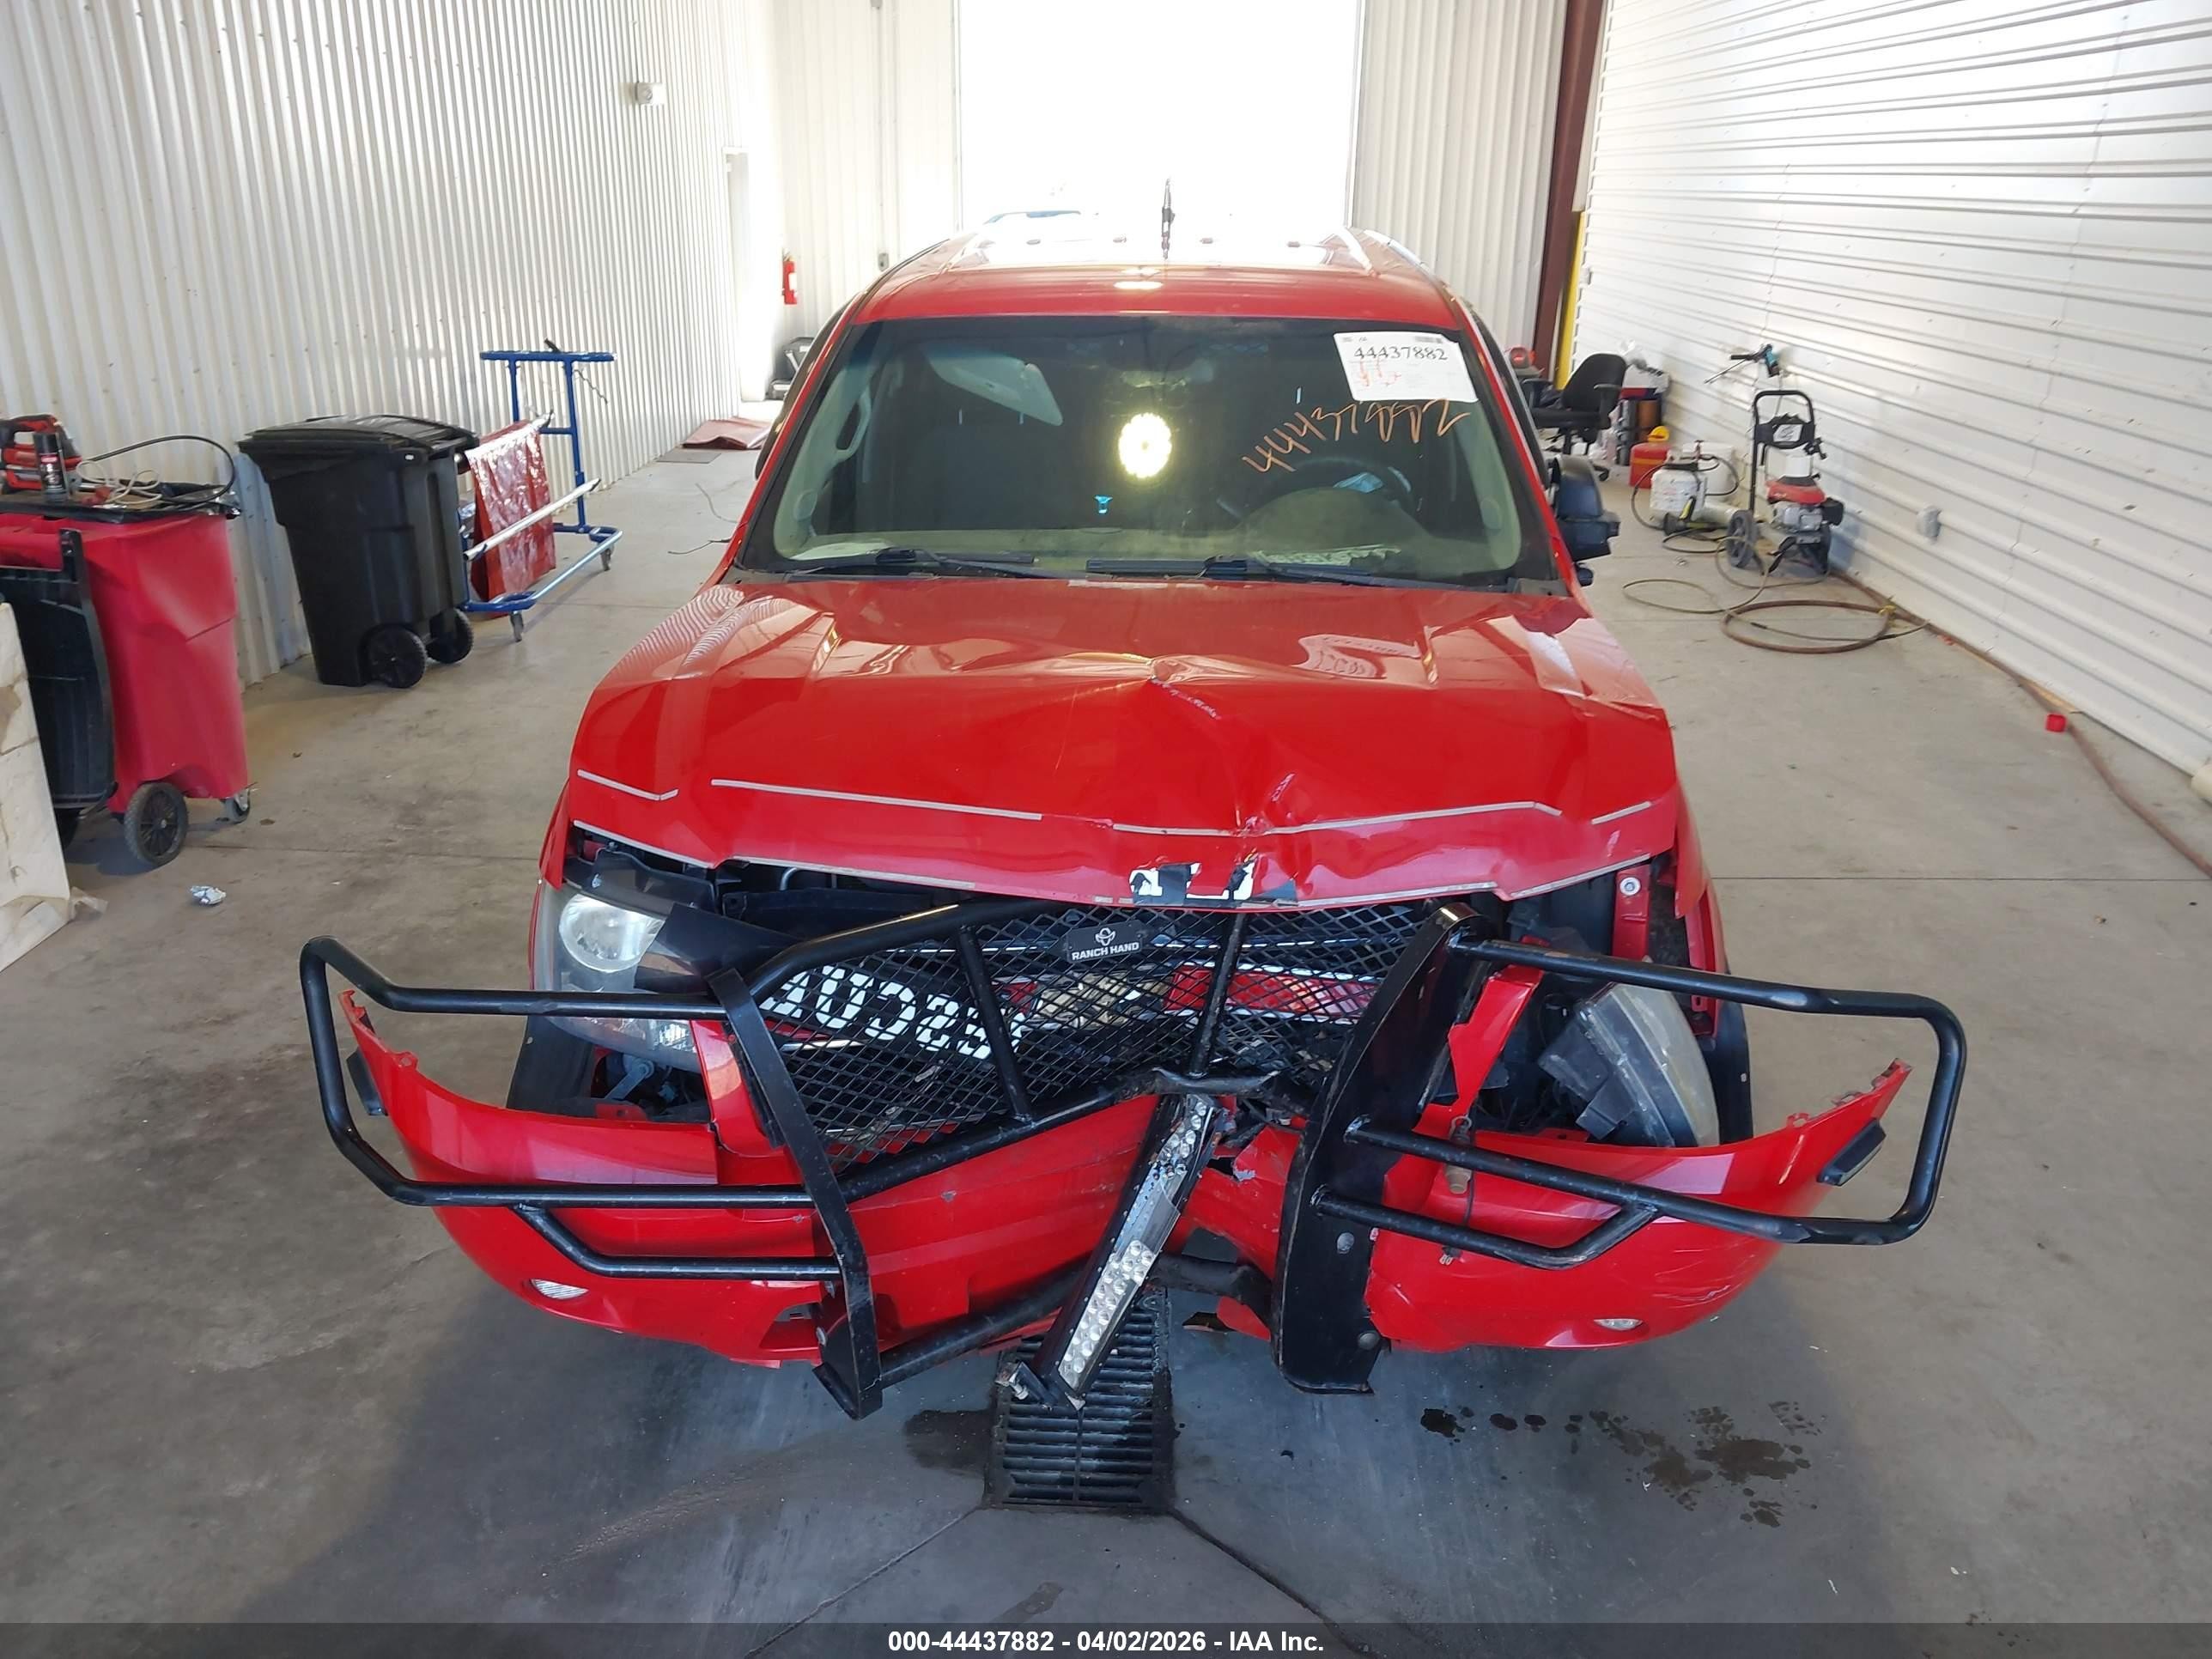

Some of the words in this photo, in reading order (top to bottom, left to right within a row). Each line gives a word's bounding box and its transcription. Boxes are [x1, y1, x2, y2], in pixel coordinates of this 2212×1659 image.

[1353, 345, 1449, 361] 44437882
[1071, 946, 1109, 961] RANCH
[1109, 941, 1140, 955] HAND
